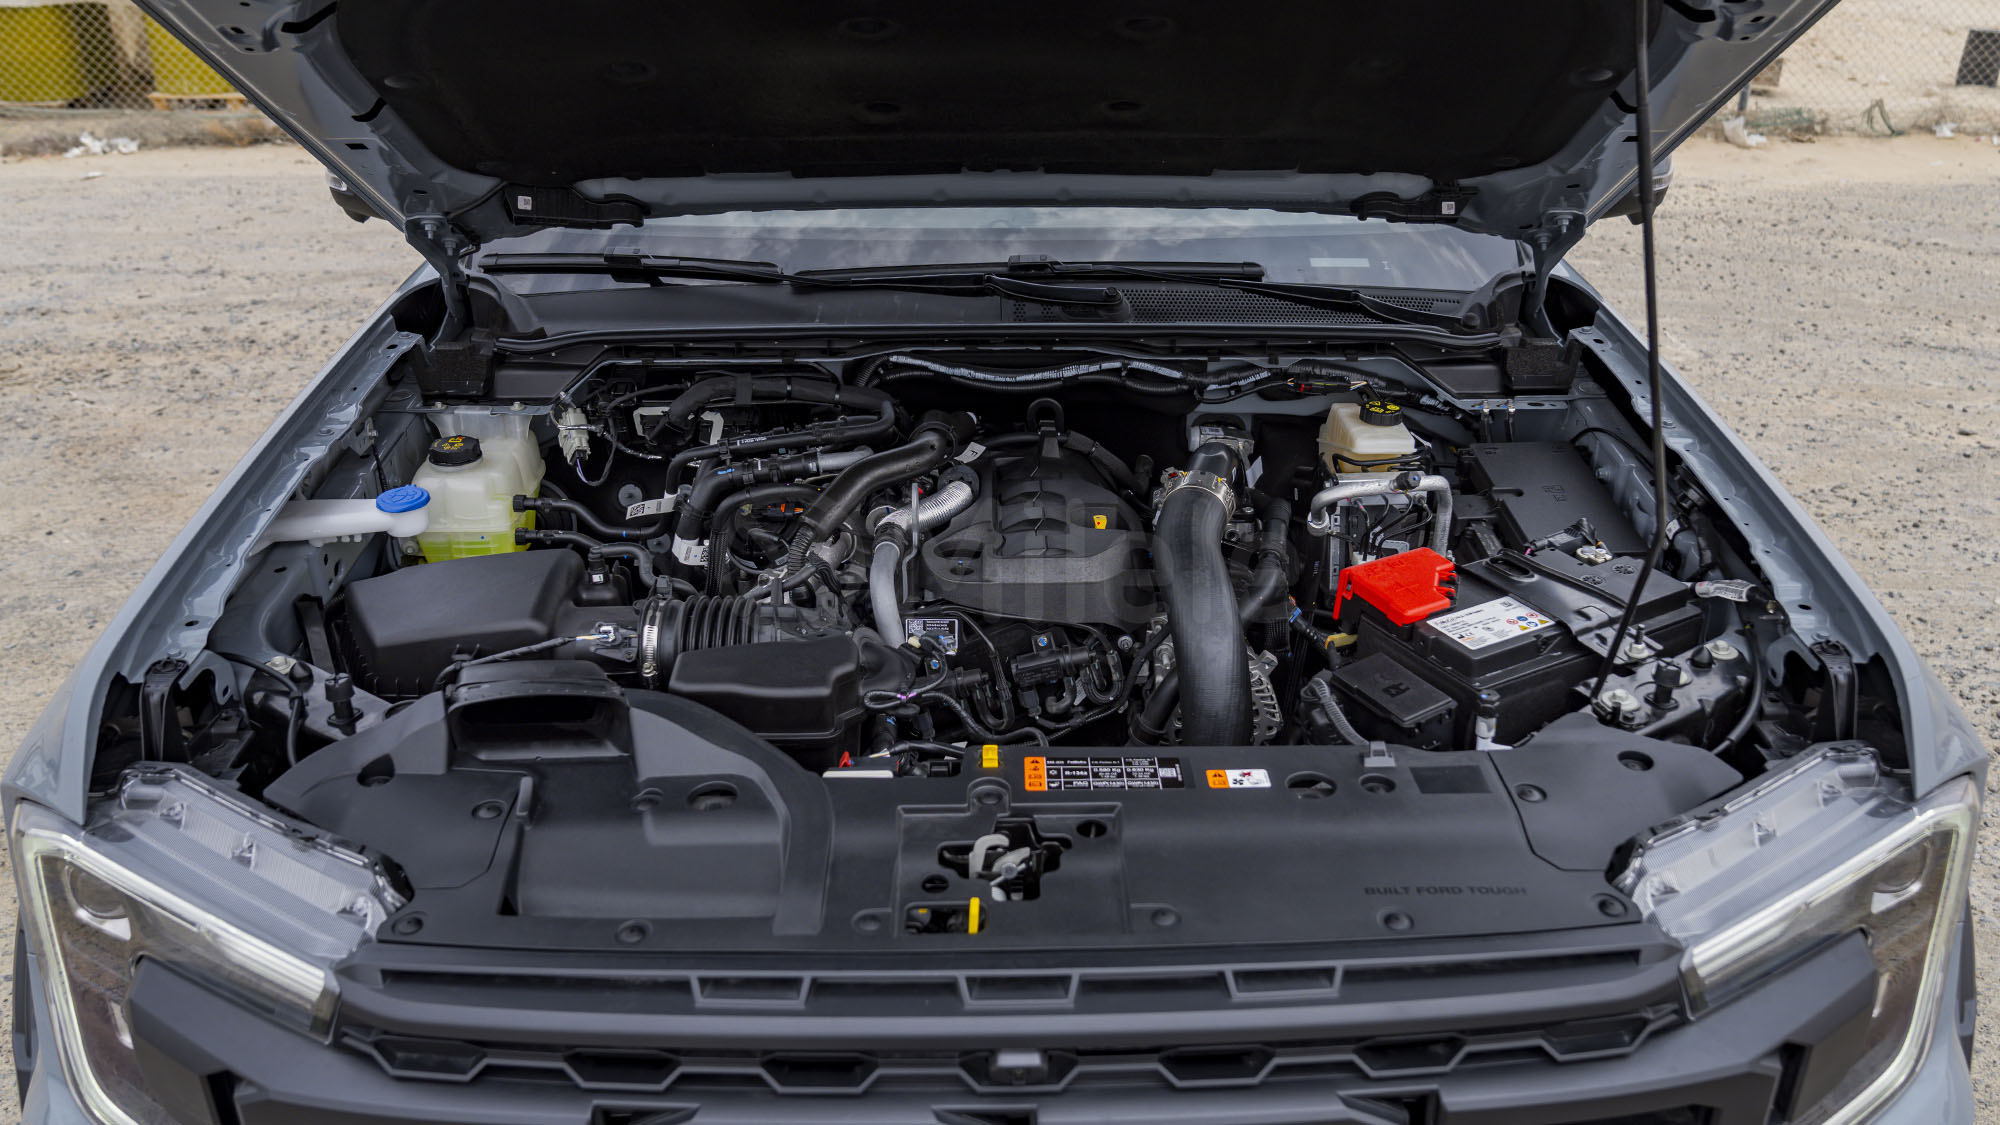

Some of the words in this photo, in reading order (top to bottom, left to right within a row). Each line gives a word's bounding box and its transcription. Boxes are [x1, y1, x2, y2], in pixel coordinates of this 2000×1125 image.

[1364, 886, 1411, 895] BUILT
[1416, 886, 1463, 895] FORD
[1467, 886, 1527, 895] TOUGH
